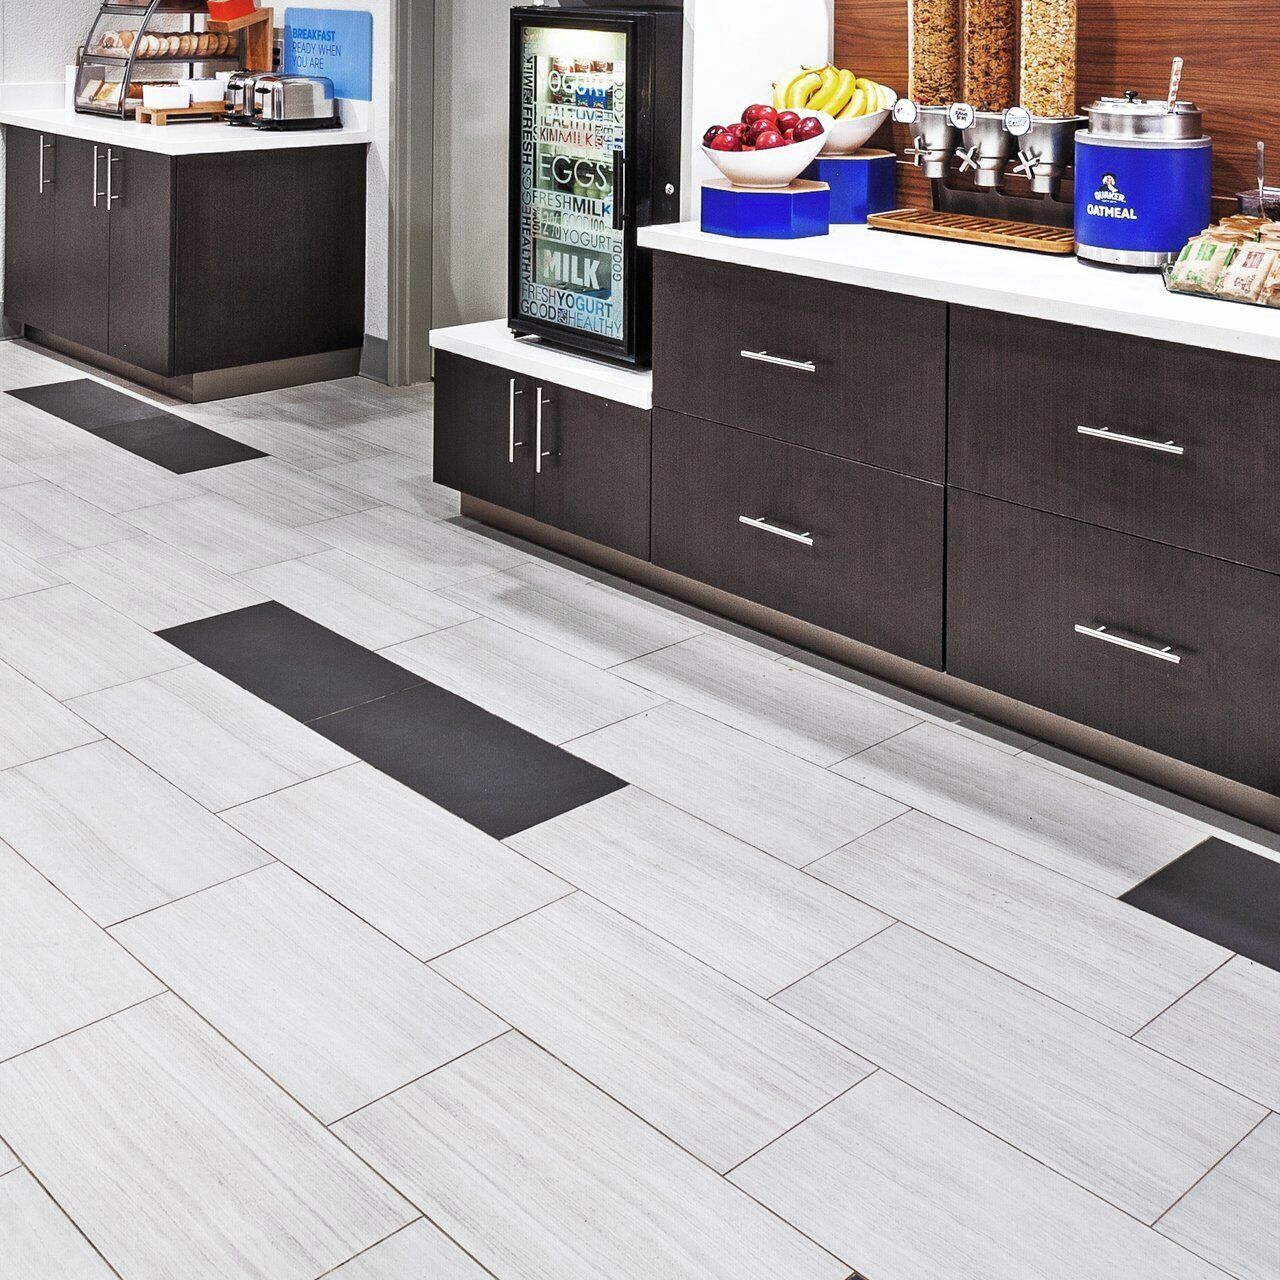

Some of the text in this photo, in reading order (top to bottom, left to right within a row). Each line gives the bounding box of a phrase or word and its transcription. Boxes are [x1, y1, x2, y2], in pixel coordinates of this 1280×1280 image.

[292, 28, 336, 42] BREAKFAST
[292, 41, 342, 57] READY WHEN
[292, 55, 324, 70] YOU ARE
[522, 107, 533, 166] FRESH
[539, 152, 608, 191] EGGS
[1094, 190, 1126, 203] QUAKER
[1086, 203, 1138, 220] OATMEAL
[561, 227, 612, 251] YOGURT
[521, 219, 531, 284] HEALTHY
[542, 248, 601, 290] MILK
[568, 310, 622, 338] HEALTHY
